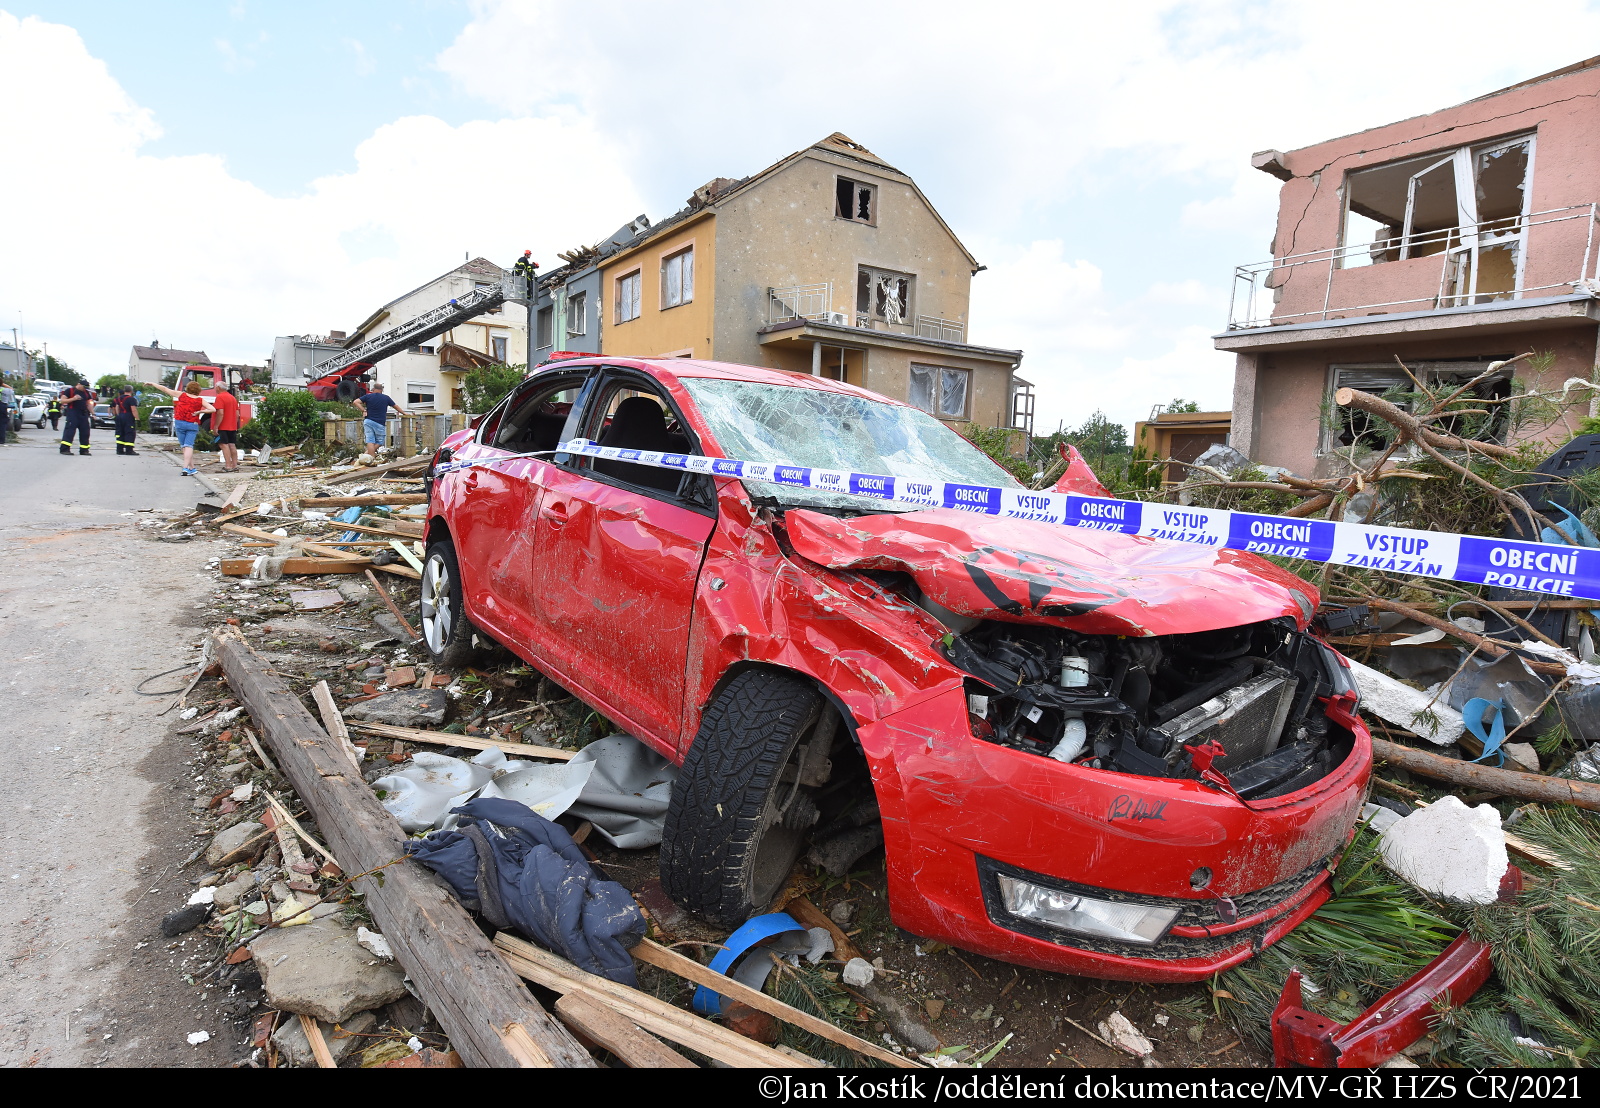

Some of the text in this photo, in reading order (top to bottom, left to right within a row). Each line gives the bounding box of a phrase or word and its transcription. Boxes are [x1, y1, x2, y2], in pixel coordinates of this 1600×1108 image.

[750, 465, 768, 476] VSTUP
[781, 469, 804, 480] OBECNÍ
[819, 472, 841, 484] VSTUP
[858, 477, 886, 491] OBECNÍ
[906, 482, 933, 496] VSTUP
[955, 488, 990, 504] OBECNÍ
[1016, 494, 1051, 511] VSTUP
[1081, 502, 1126, 520] OBECNÍ
[1163, 511, 1209, 530] VSTUP
[1250, 521, 1312, 543] OBECNÍ
[1244, 541, 1310, 559] POLICIE
[1364, 533, 1430, 557] VSTUP
[1489, 547, 1578, 575] OBECNÍ
[1483, 571, 1576, 596] POLICIE
